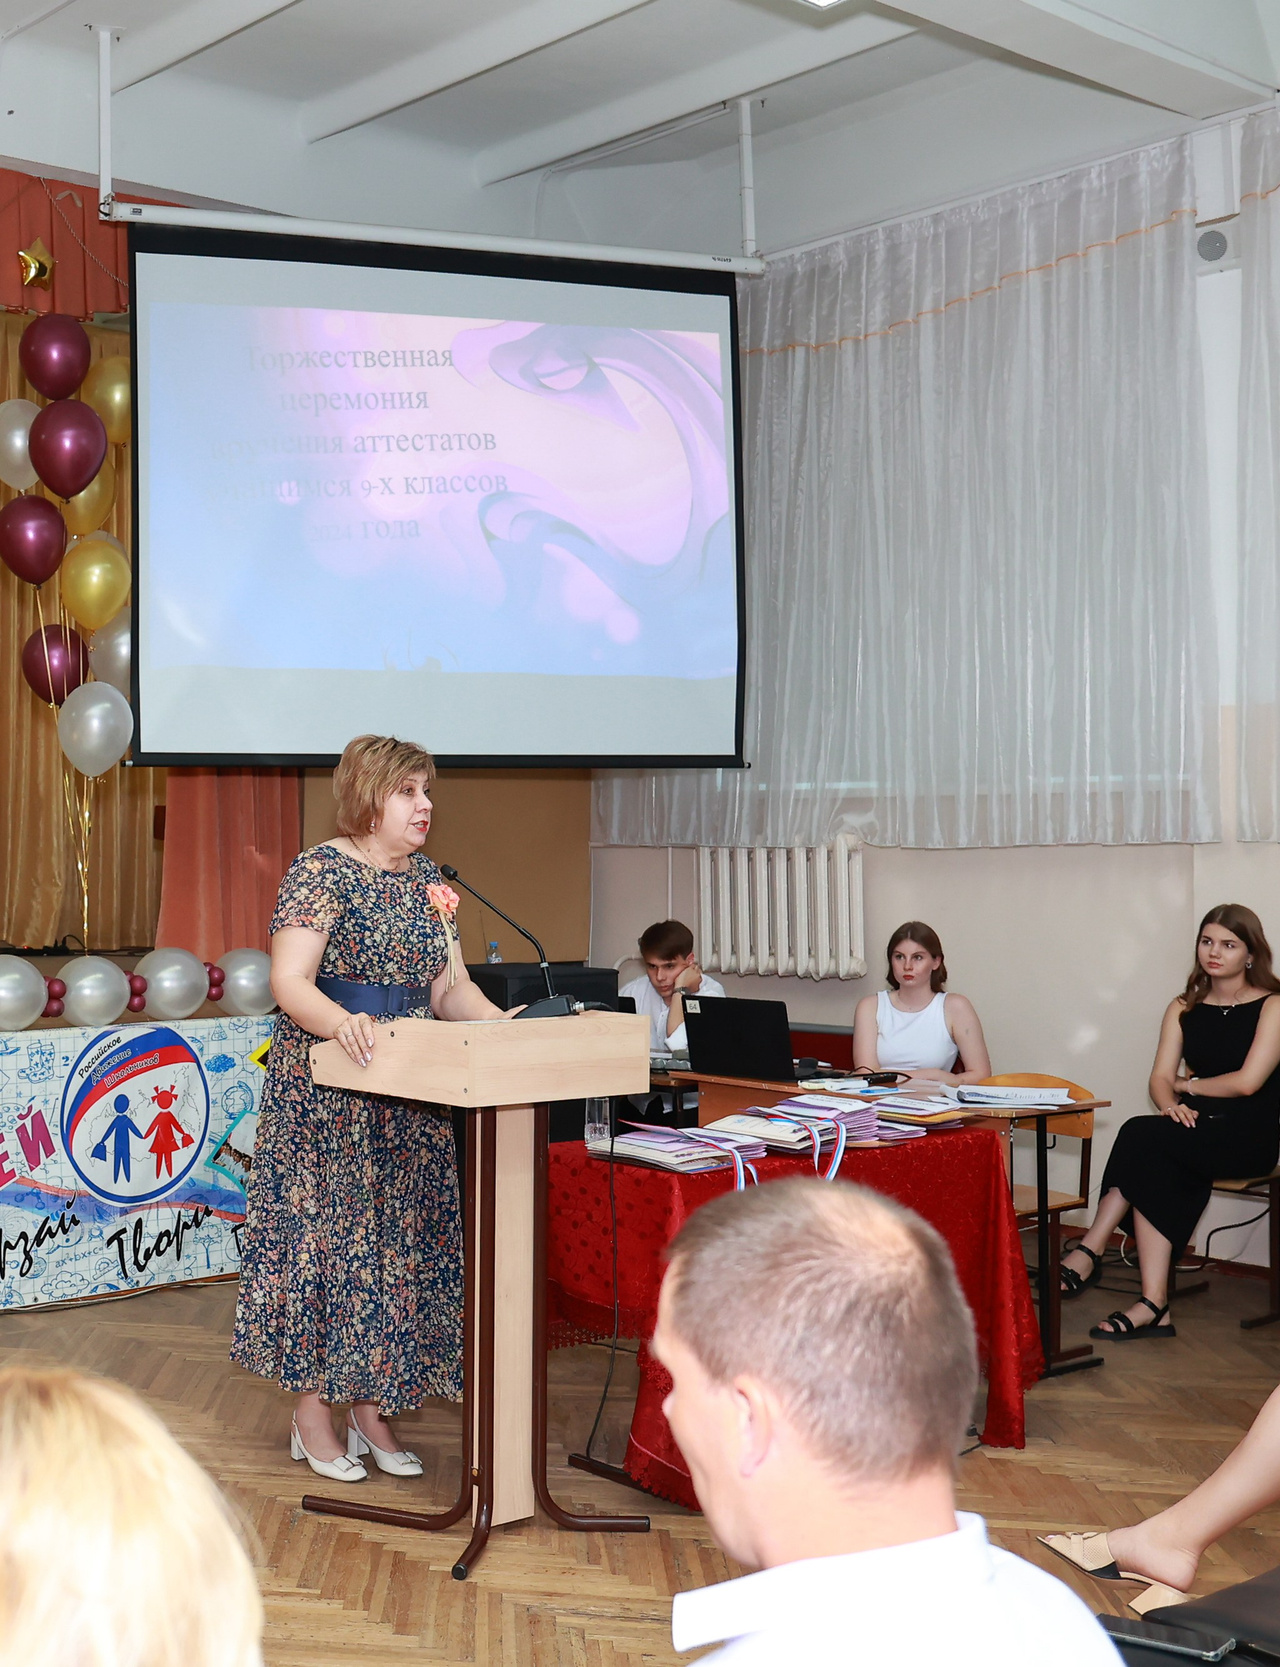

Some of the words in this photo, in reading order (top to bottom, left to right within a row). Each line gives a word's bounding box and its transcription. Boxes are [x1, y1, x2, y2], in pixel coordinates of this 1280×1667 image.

[244, 346, 454, 376] Торжественная
[280, 390, 430, 417] церемония
[353, 432, 497, 453] аттестатов
[404, 473, 508, 496] классов
[361, 518, 421, 541] года
[78, 1036, 122, 1079] Российское
[91, 1049, 132, 1085] Движение
[104, 1053, 159, 1088] Школьников
[107, 1204, 214, 1279] Твори
